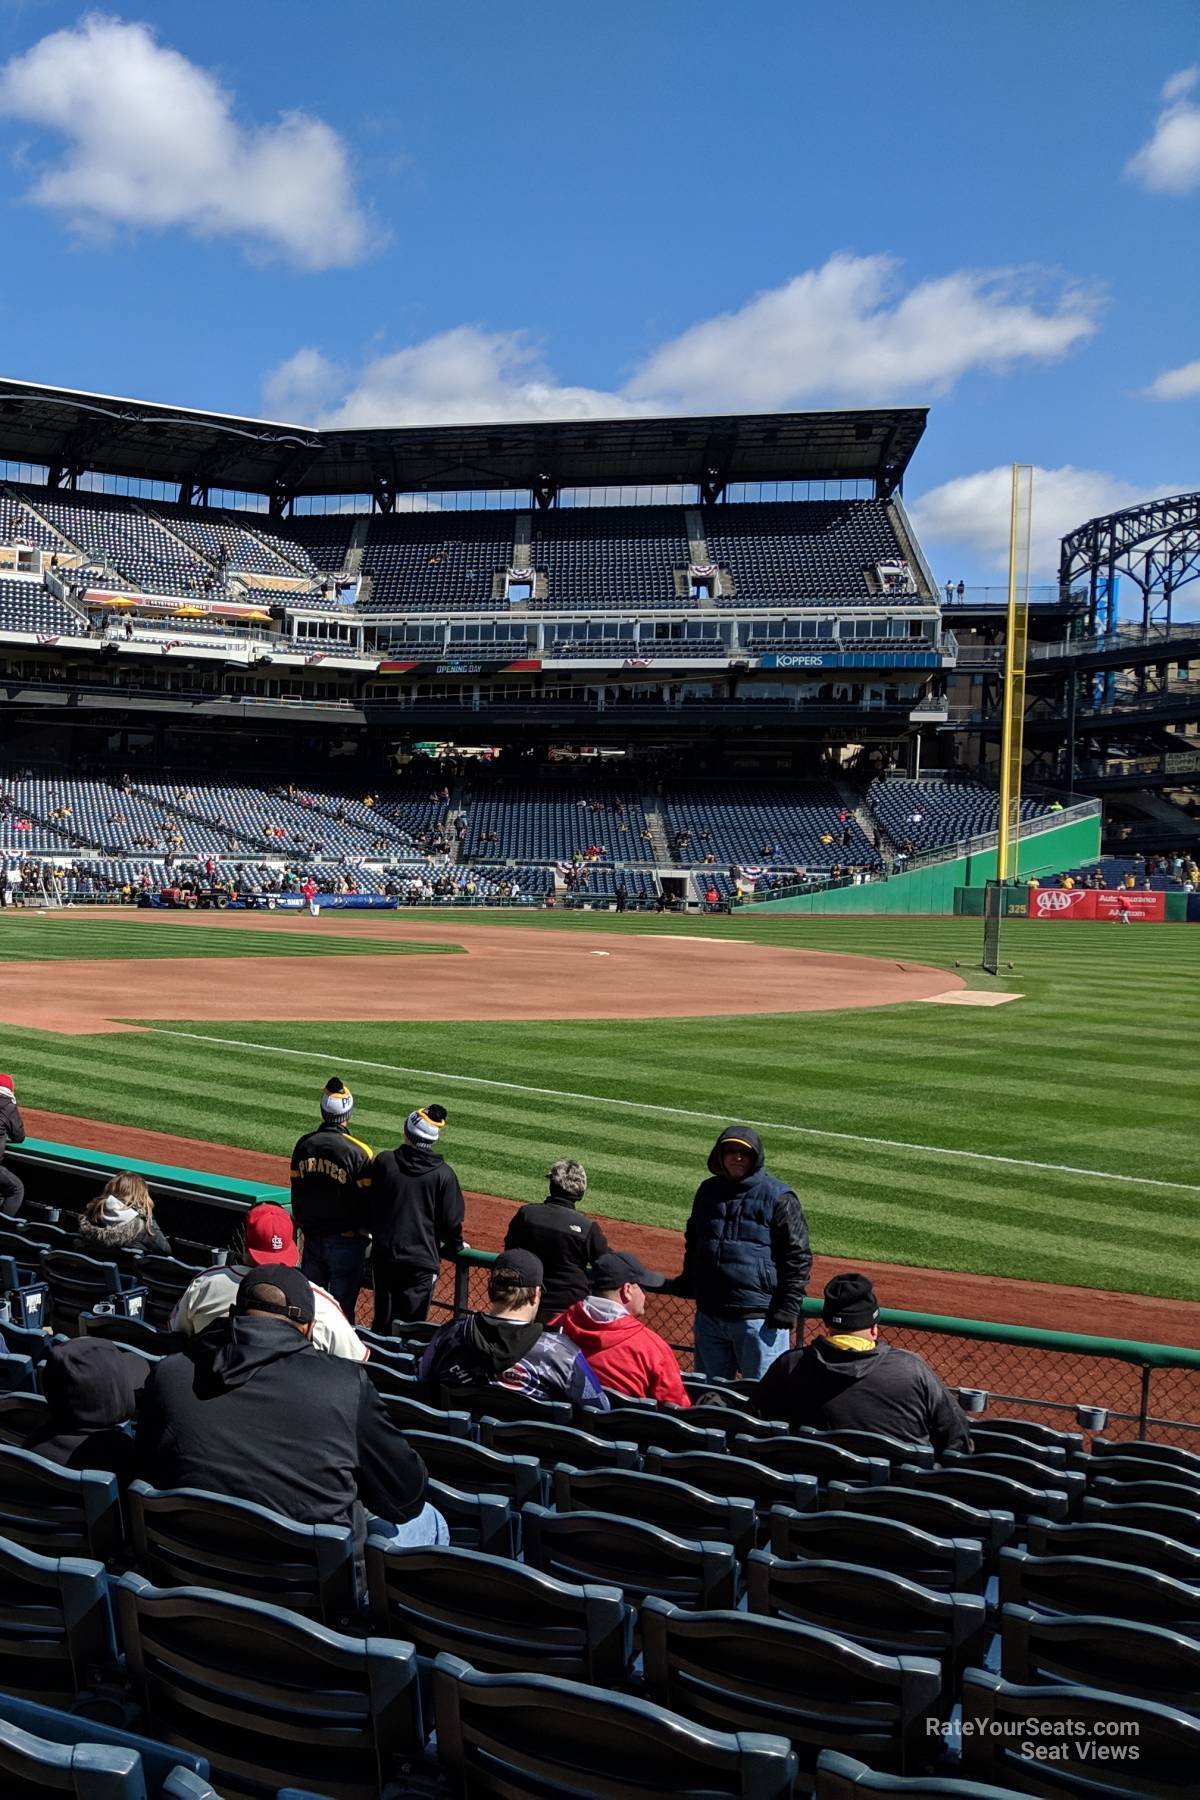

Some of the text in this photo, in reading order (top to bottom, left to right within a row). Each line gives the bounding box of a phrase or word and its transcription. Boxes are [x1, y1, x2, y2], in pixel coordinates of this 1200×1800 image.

[437, 664, 468, 673] OPENING
[776, 654, 824, 668] KOPPERS
[1041, 891, 1069, 910] AAA
[1008, 904, 1027, 914] 325
[298, 1157, 347, 1185] PIRATES
[449, 1364, 473, 1385] CHI
